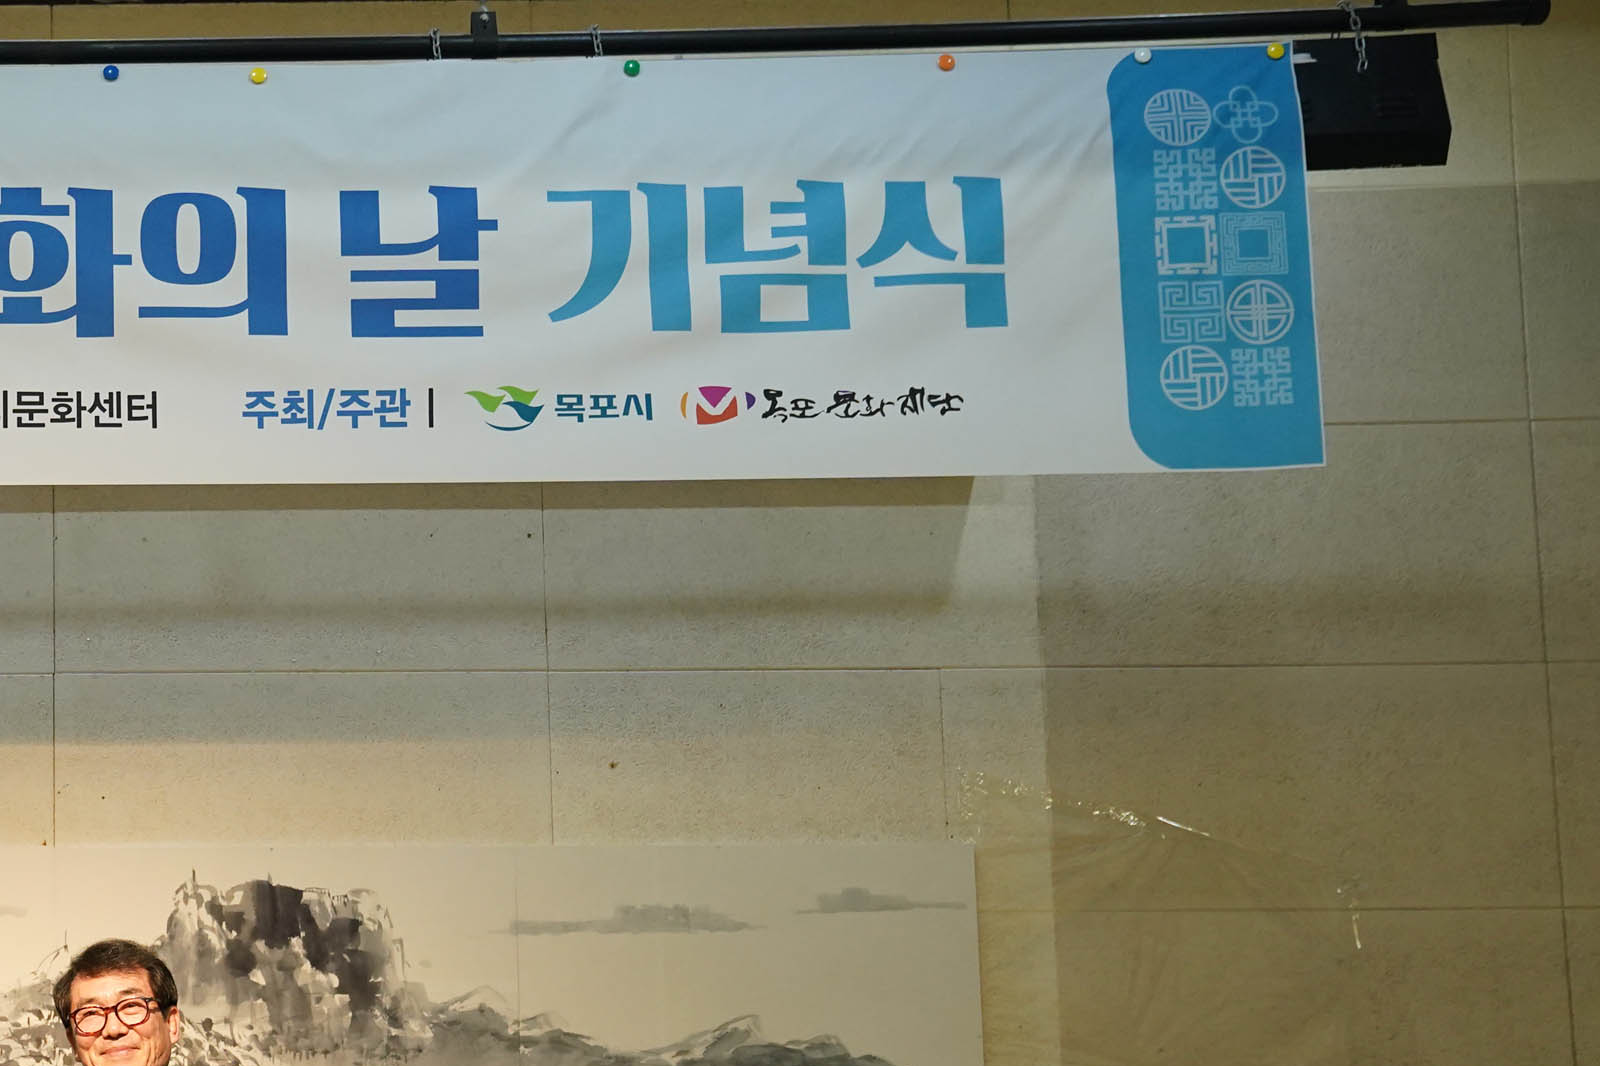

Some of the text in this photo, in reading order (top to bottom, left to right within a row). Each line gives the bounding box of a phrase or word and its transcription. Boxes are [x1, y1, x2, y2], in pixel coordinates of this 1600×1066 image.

[339, 185, 498, 338] 날
[547, 176, 1008, 333] 기념식
[242, 388, 411, 430] 주최/주관
[554, 393, 653, 423] 목포시
